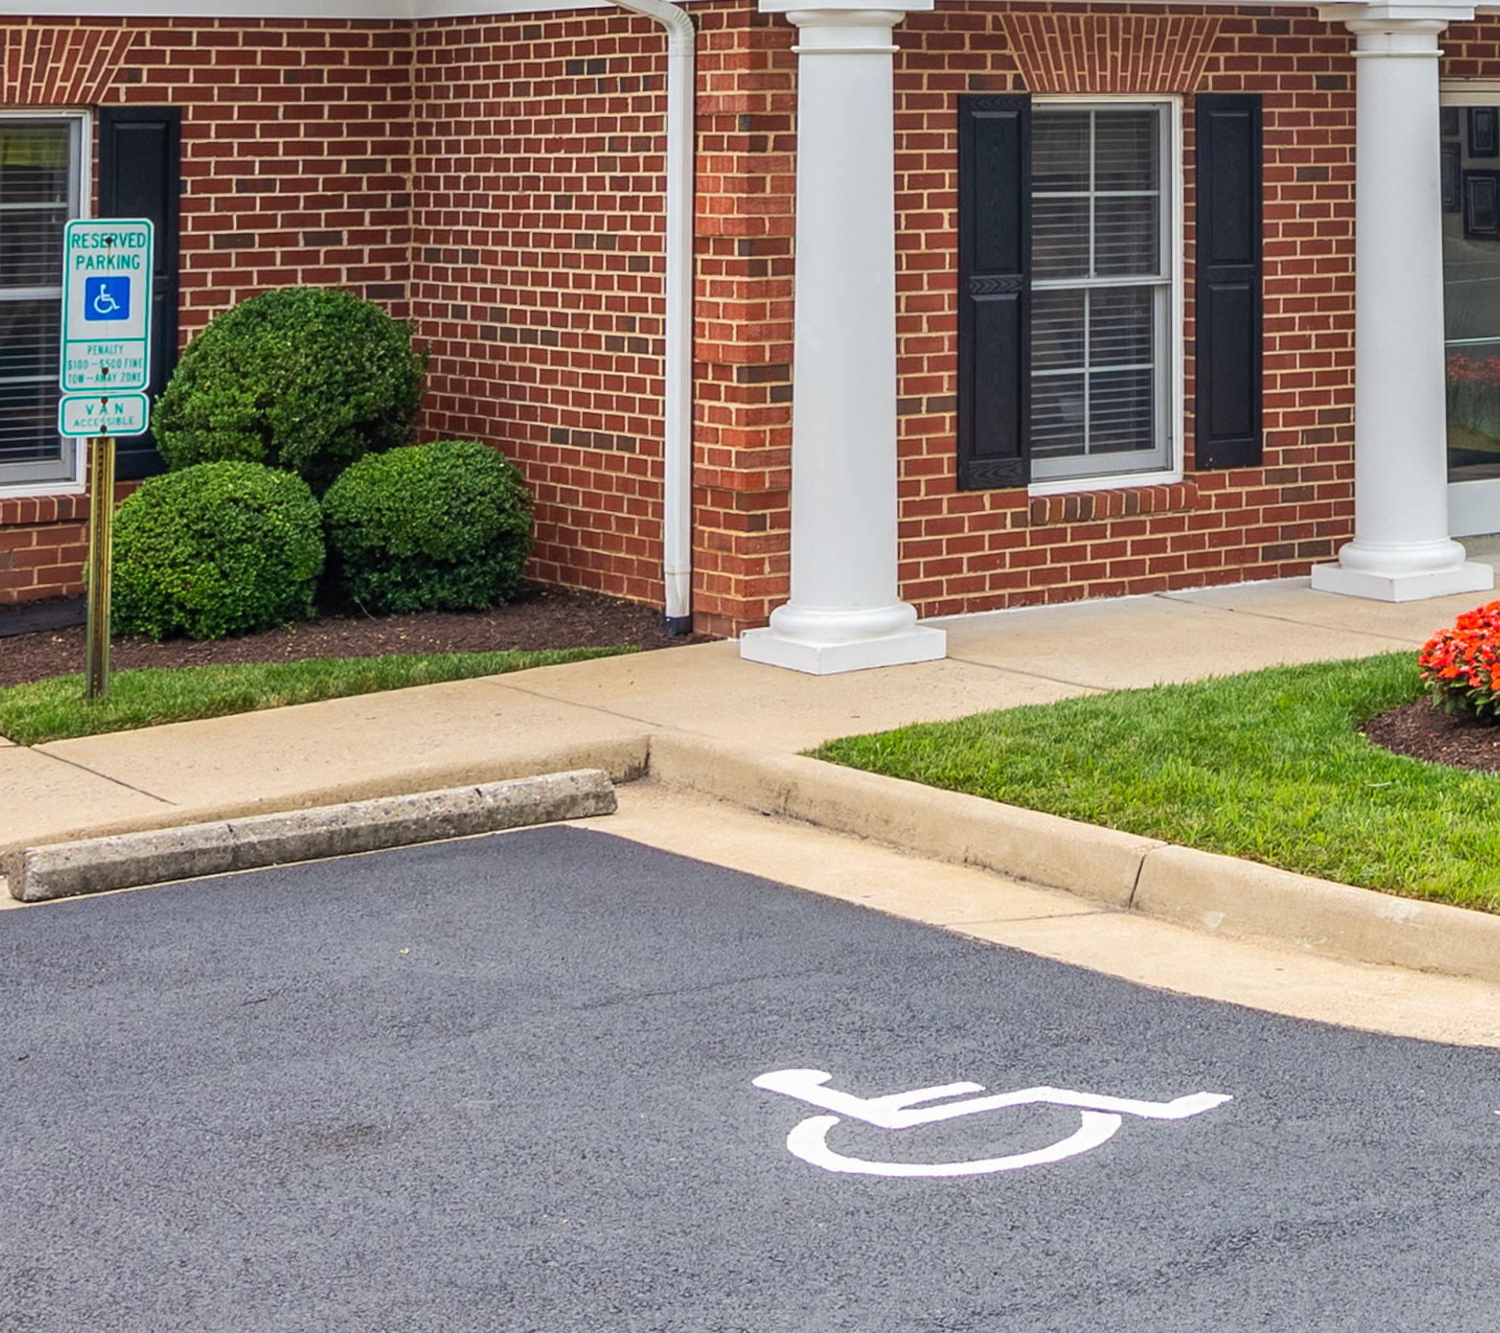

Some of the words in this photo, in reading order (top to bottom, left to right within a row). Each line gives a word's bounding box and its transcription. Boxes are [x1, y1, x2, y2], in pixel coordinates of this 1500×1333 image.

[71, 232, 146, 249] RESERVED
[76, 254, 141, 270] PARKING
[87, 344, 124, 355] PENALTY
[125, 357, 143, 368] FINE
[121, 372, 142, 382] ZONE
[85, 403, 124, 415] VAN
[74, 416, 134, 428] ACCESSIBLE
